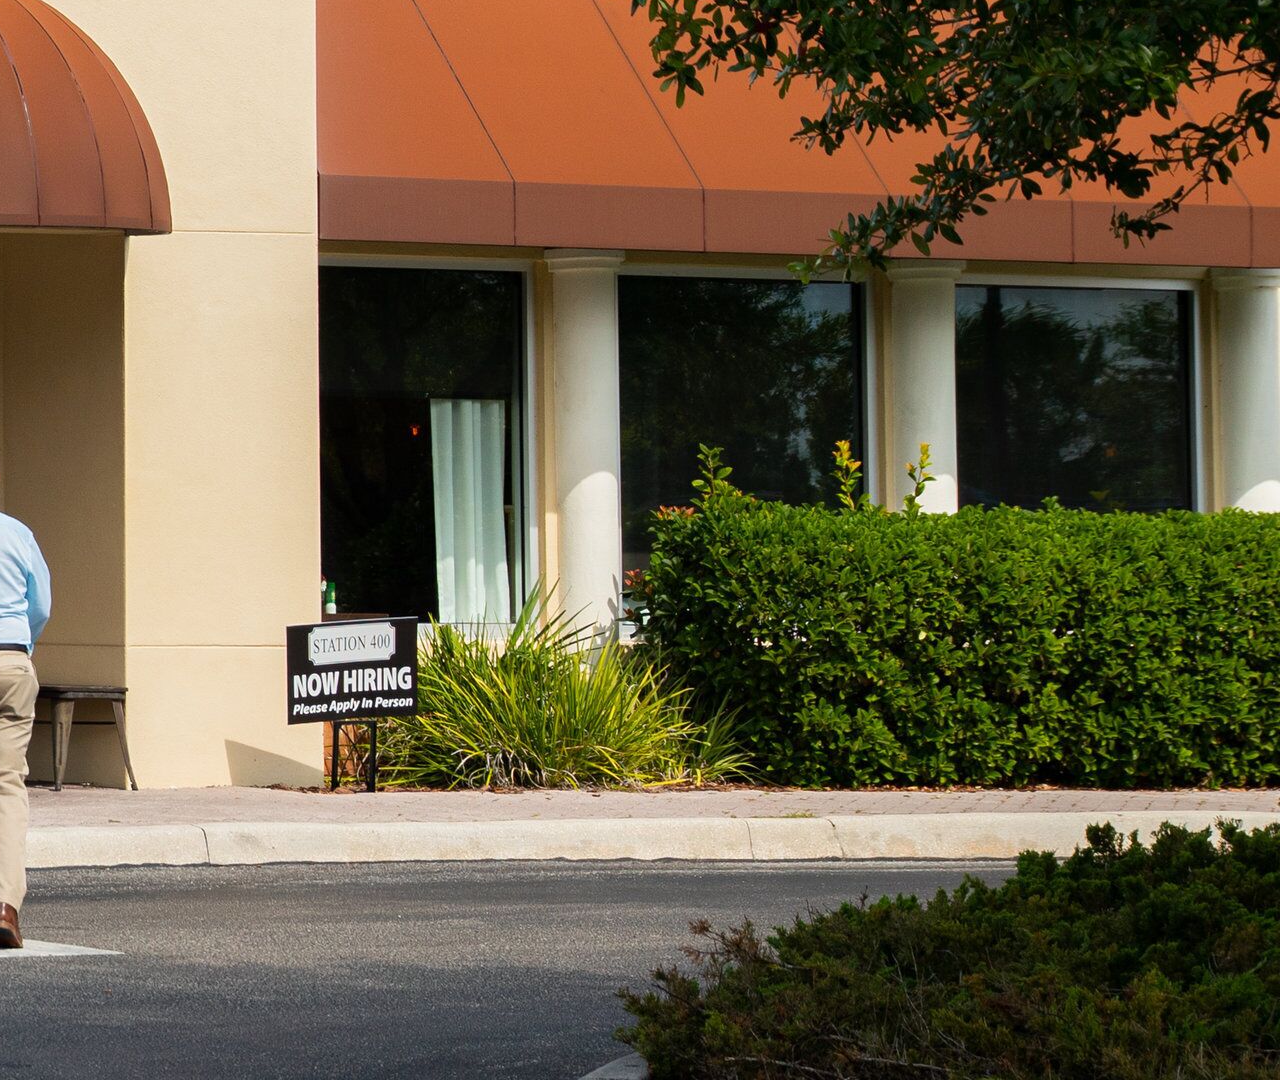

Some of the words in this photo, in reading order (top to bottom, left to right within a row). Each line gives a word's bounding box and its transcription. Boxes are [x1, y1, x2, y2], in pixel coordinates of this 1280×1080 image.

[313, 635, 366, 654] STATION
[371, 634, 390, 649] 400
[294, 671, 339, 698] NOW
[344, 667, 412, 693] HIRING
[293, 703, 328, 715] Please
[329, 699, 360, 713] Apply
[362, 698, 372, 708] In
[375, 697, 413, 708] Person
